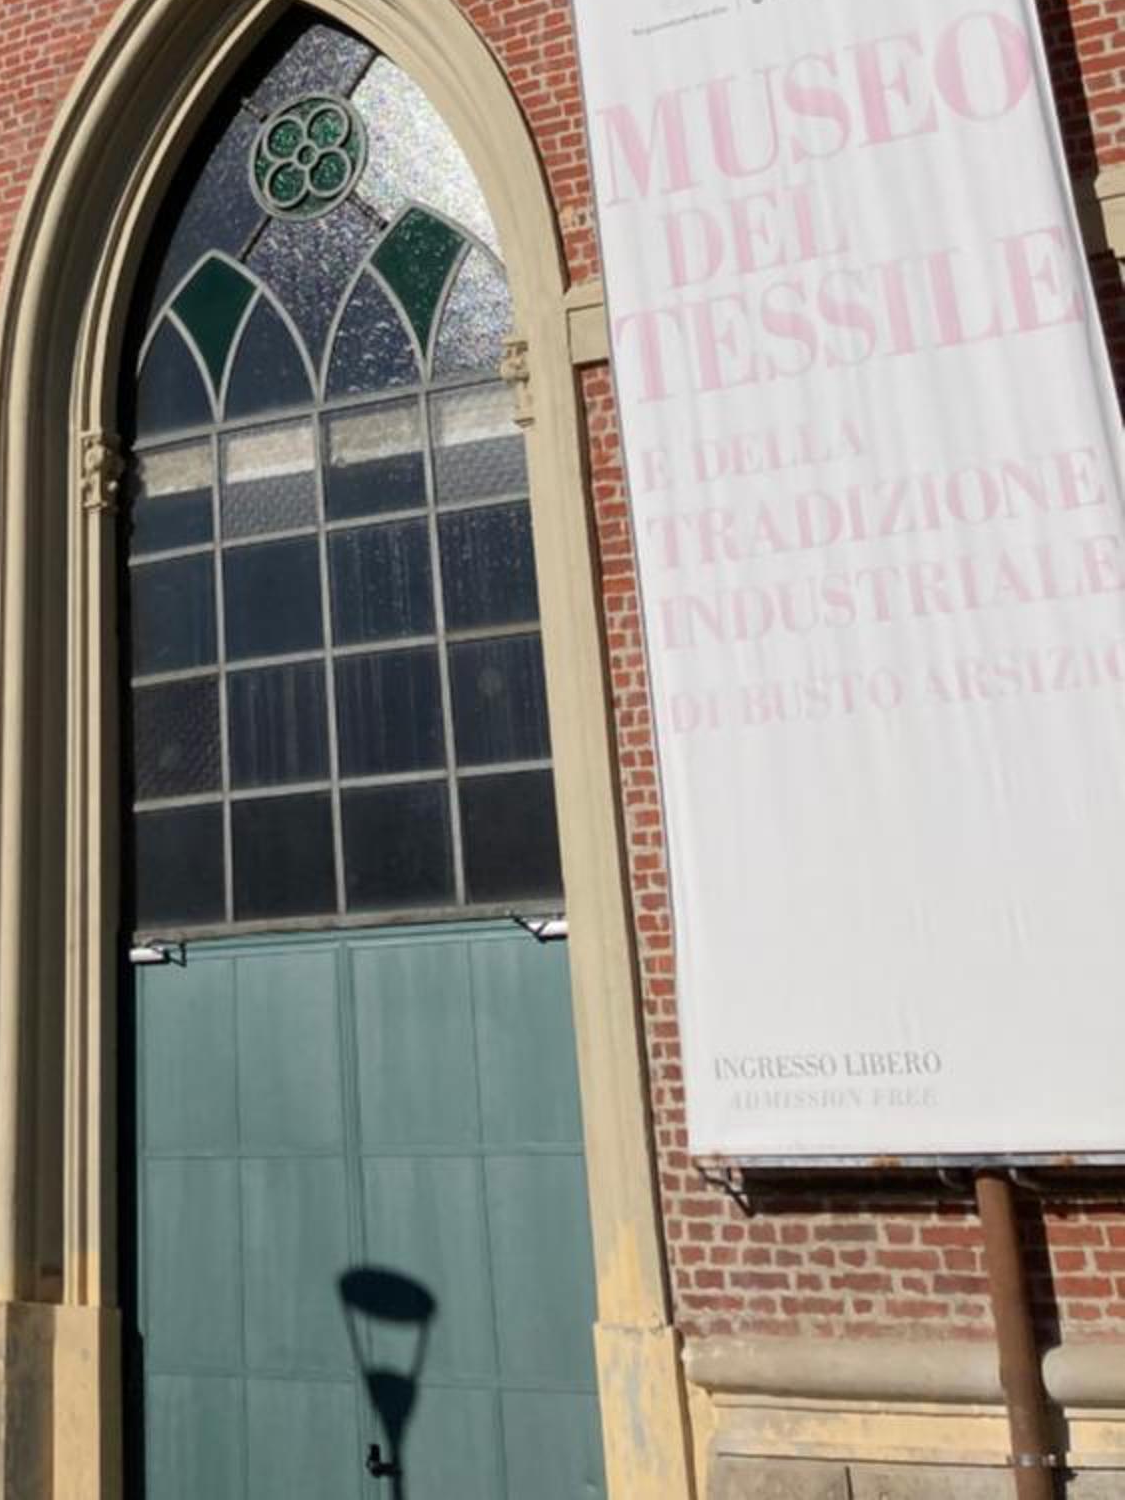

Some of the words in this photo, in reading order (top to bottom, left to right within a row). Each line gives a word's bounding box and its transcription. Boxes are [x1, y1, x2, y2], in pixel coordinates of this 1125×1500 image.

[596, 10, 1033, 208] MUSEO
[660, 180, 850, 291] DEL
[614, 227, 1086, 405] TESSILE
[642, 450, 669, 493] E
[693, 419, 864, 484] DELLA
[647, 446, 1108, 570] TRADIZIONE
[658, 533, 1125, 652] INDUSTRIALE
[670, 691, 725, 736] DI
[741, 669, 909, 727] BUSTO
[713, 1051, 838, 1080] INGRESSO
[844, 1049, 944, 1077] LIBERO
[730, 1087, 863, 1110] ADMISSION
[871, 1086, 940, 1109] FREE
